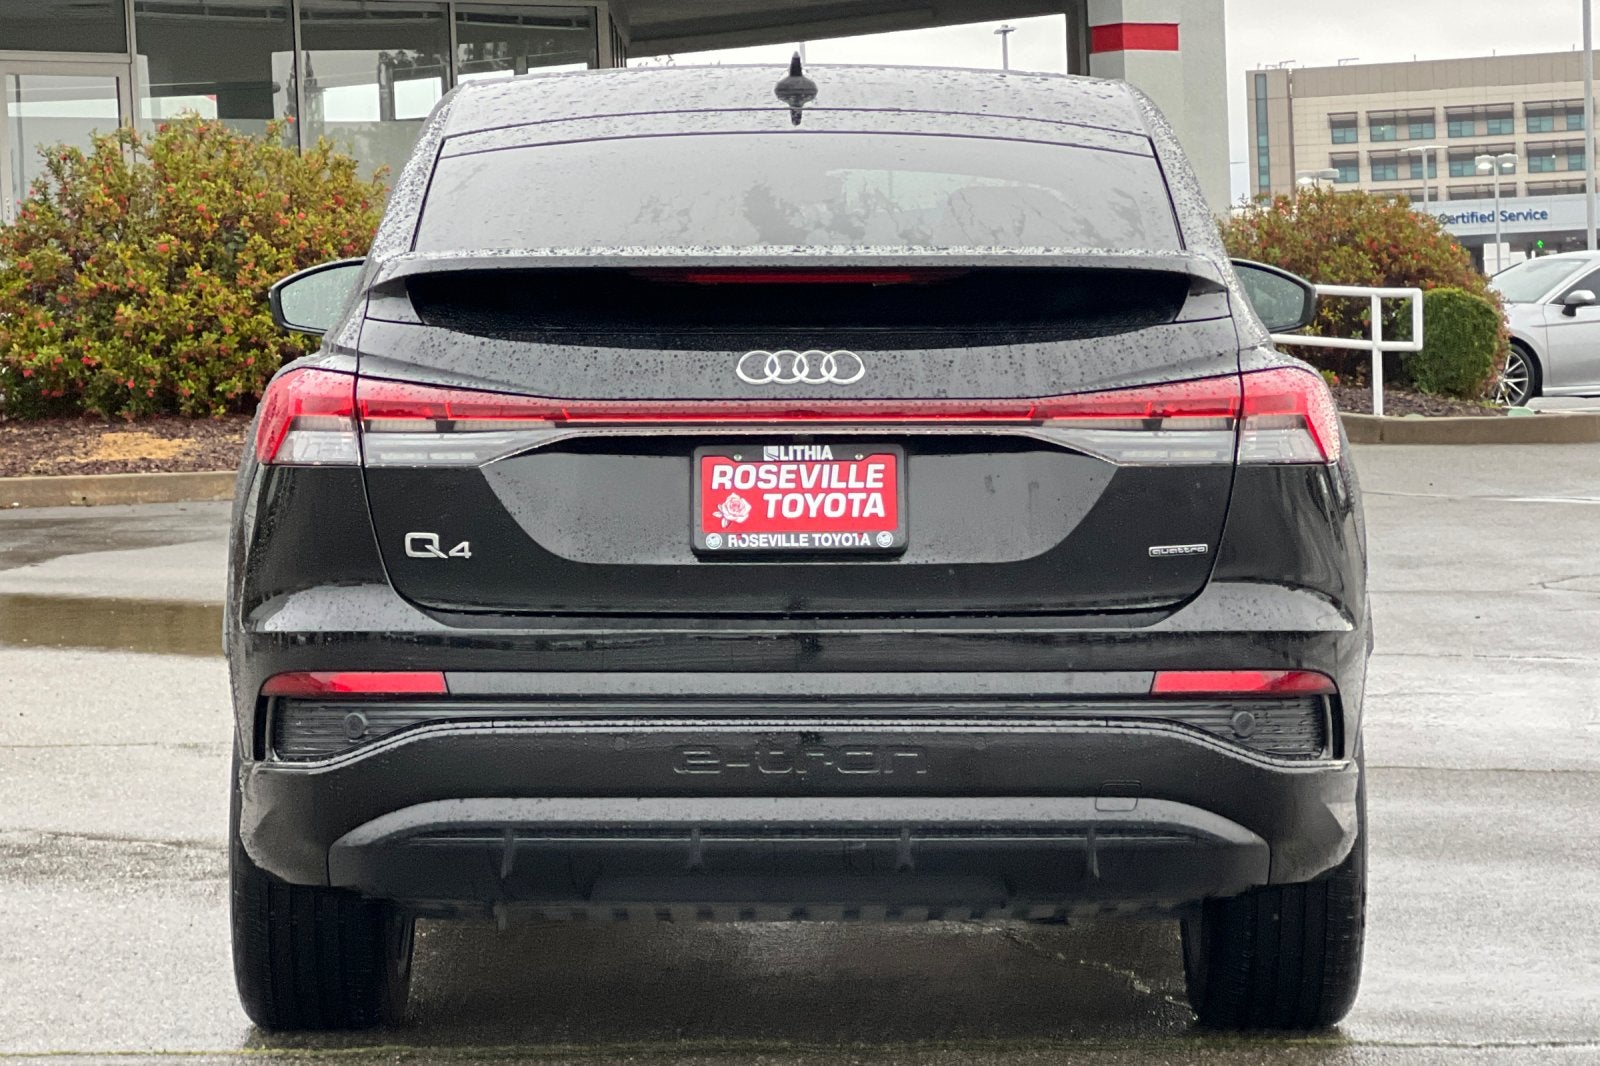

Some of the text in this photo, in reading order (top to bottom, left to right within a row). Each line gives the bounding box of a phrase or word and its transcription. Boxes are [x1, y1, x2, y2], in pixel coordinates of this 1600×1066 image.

[1500, 209, 1548, 223] Service
[779, 445, 833, 461] LITHIA
[711, 464, 885, 490] ROSEVILLE
[763, 493, 886, 518] TOYOTA
[405, 532, 472, 559] Q4
[728, 532, 871, 548] ROSEVILLE TOYOTA
[1151, 545, 1206, 556] quattro
[673, 744, 927, 773] e-tron
